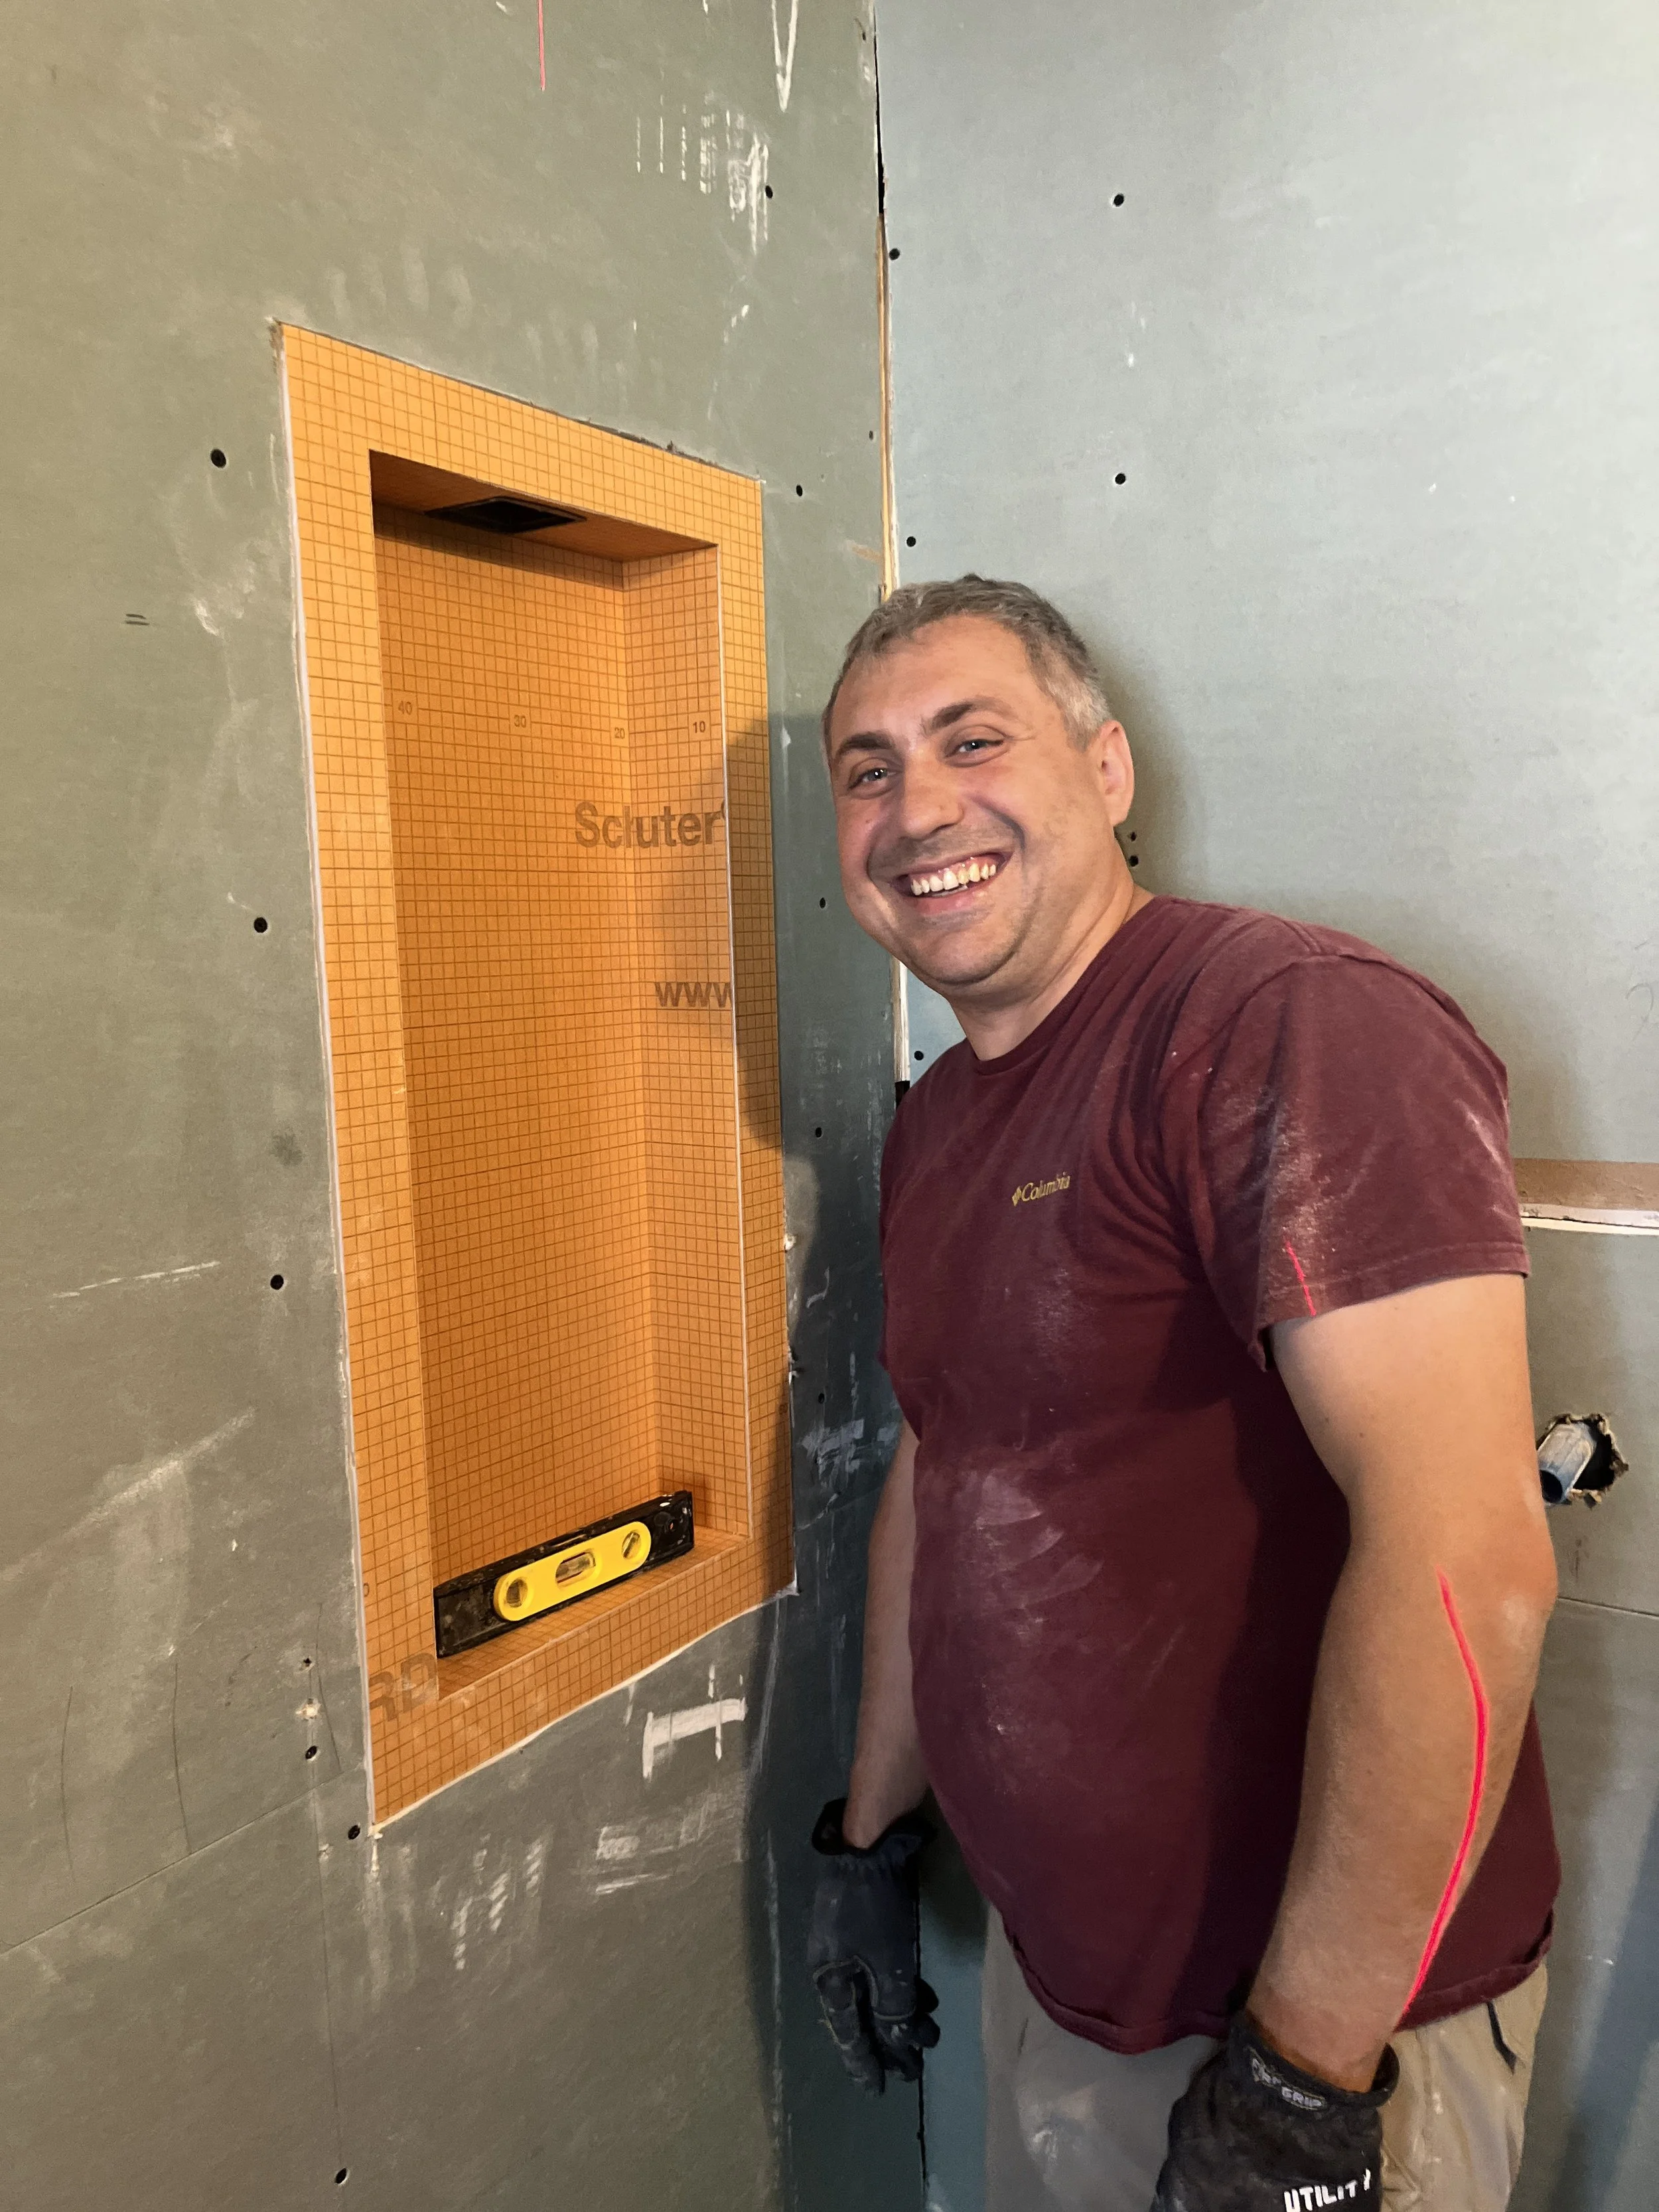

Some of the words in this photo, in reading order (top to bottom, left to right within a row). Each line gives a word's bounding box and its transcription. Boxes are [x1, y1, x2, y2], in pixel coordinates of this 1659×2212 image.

[398, 701, 413, 715] 40
[514, 715, 526, 727] 30
[614, 727, 625, 739] 20
[693, 721, 706, 733] 10
[1021, 1171, 1070, 1201] Columbia
